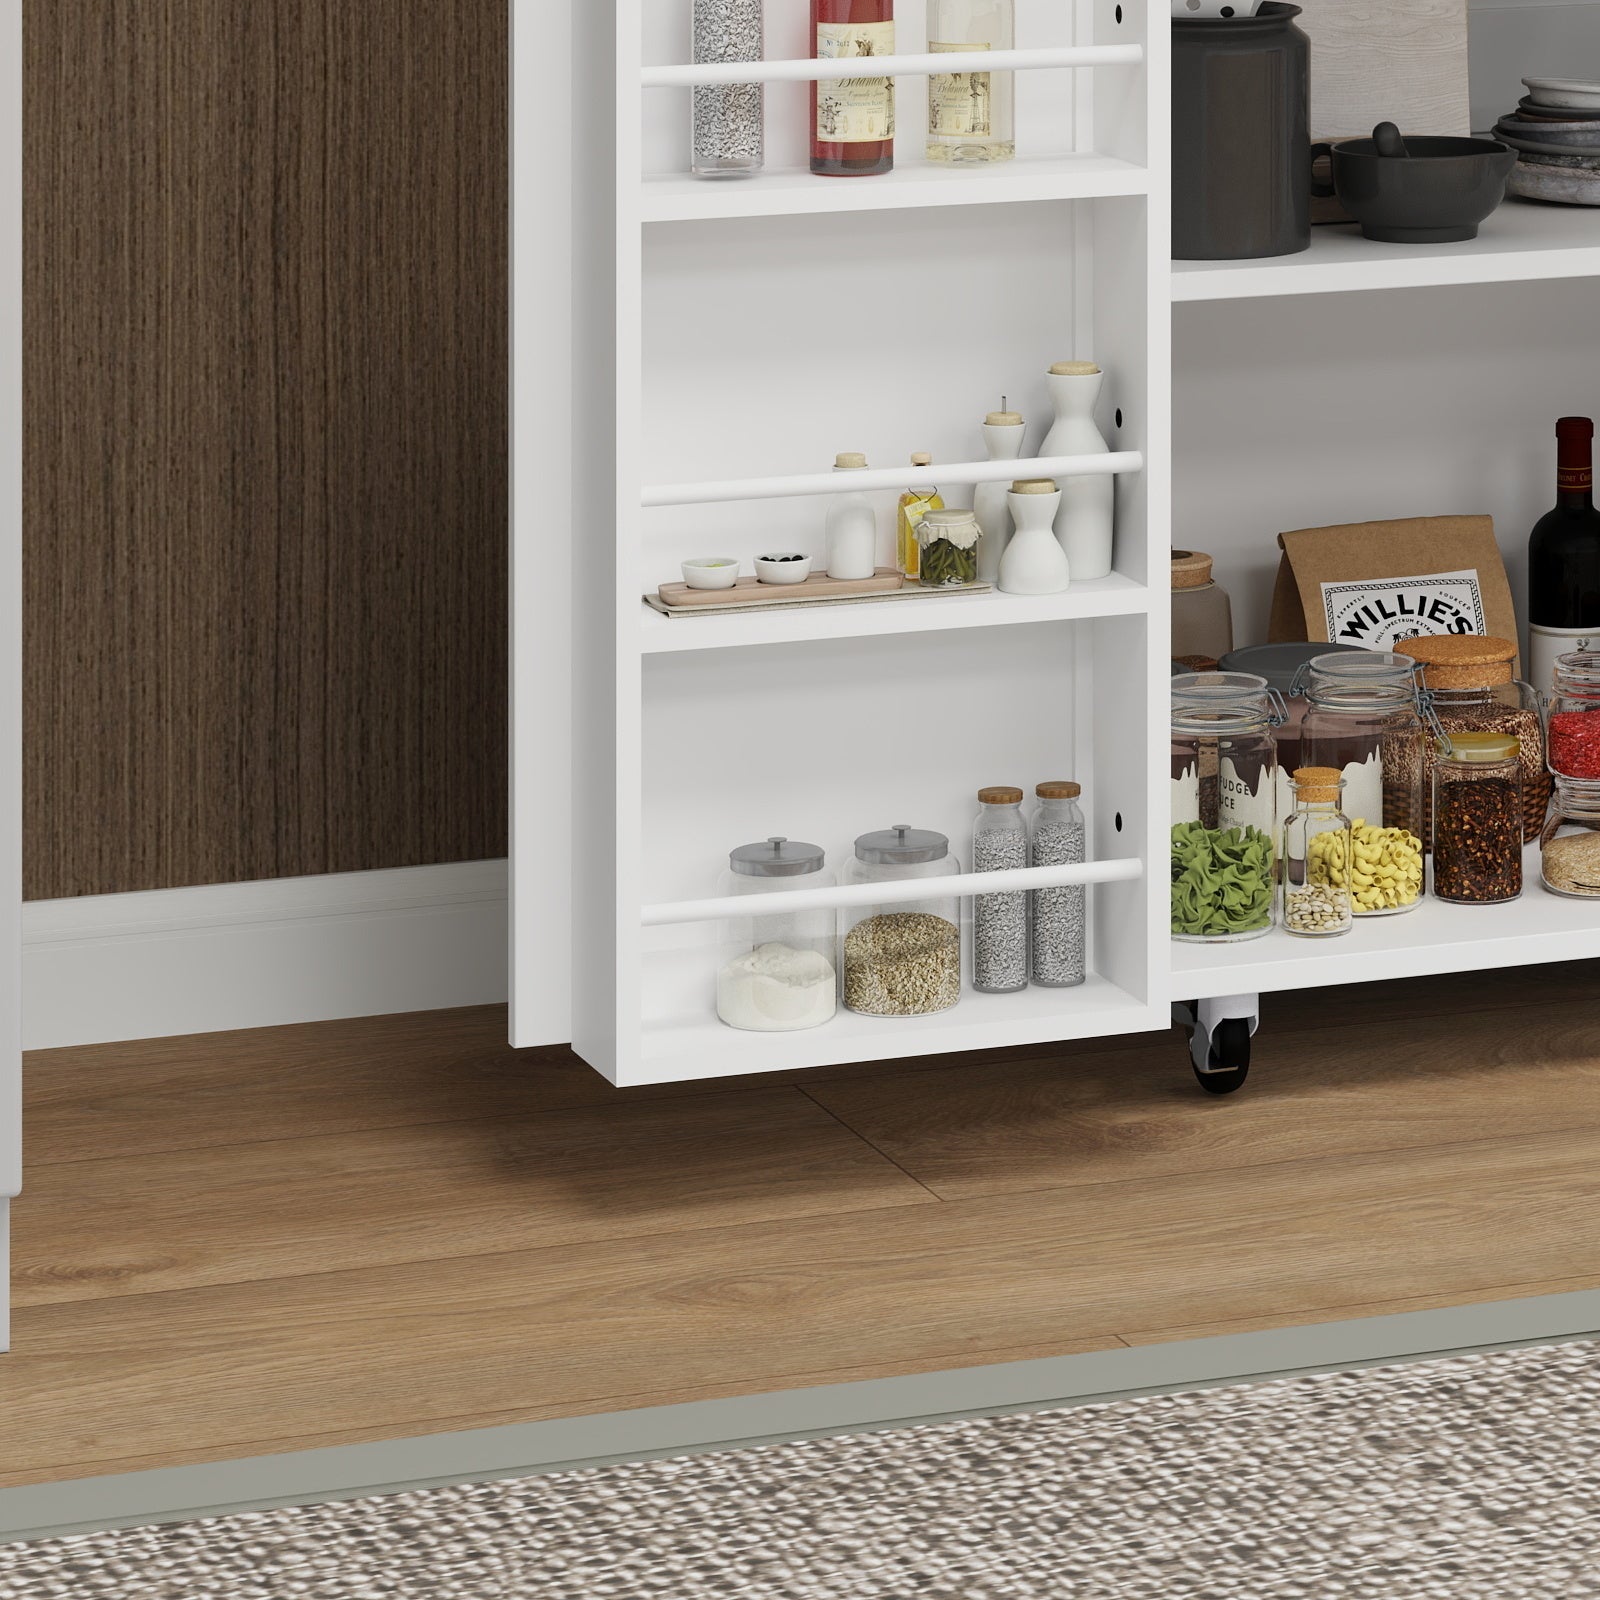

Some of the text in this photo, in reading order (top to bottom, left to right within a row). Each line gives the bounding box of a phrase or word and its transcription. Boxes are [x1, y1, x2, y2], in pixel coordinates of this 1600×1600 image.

[1336, 590, 1472, 619] EXPERTLY SOURCED
[1339, 593, 1474, 640] WILLIE'S
